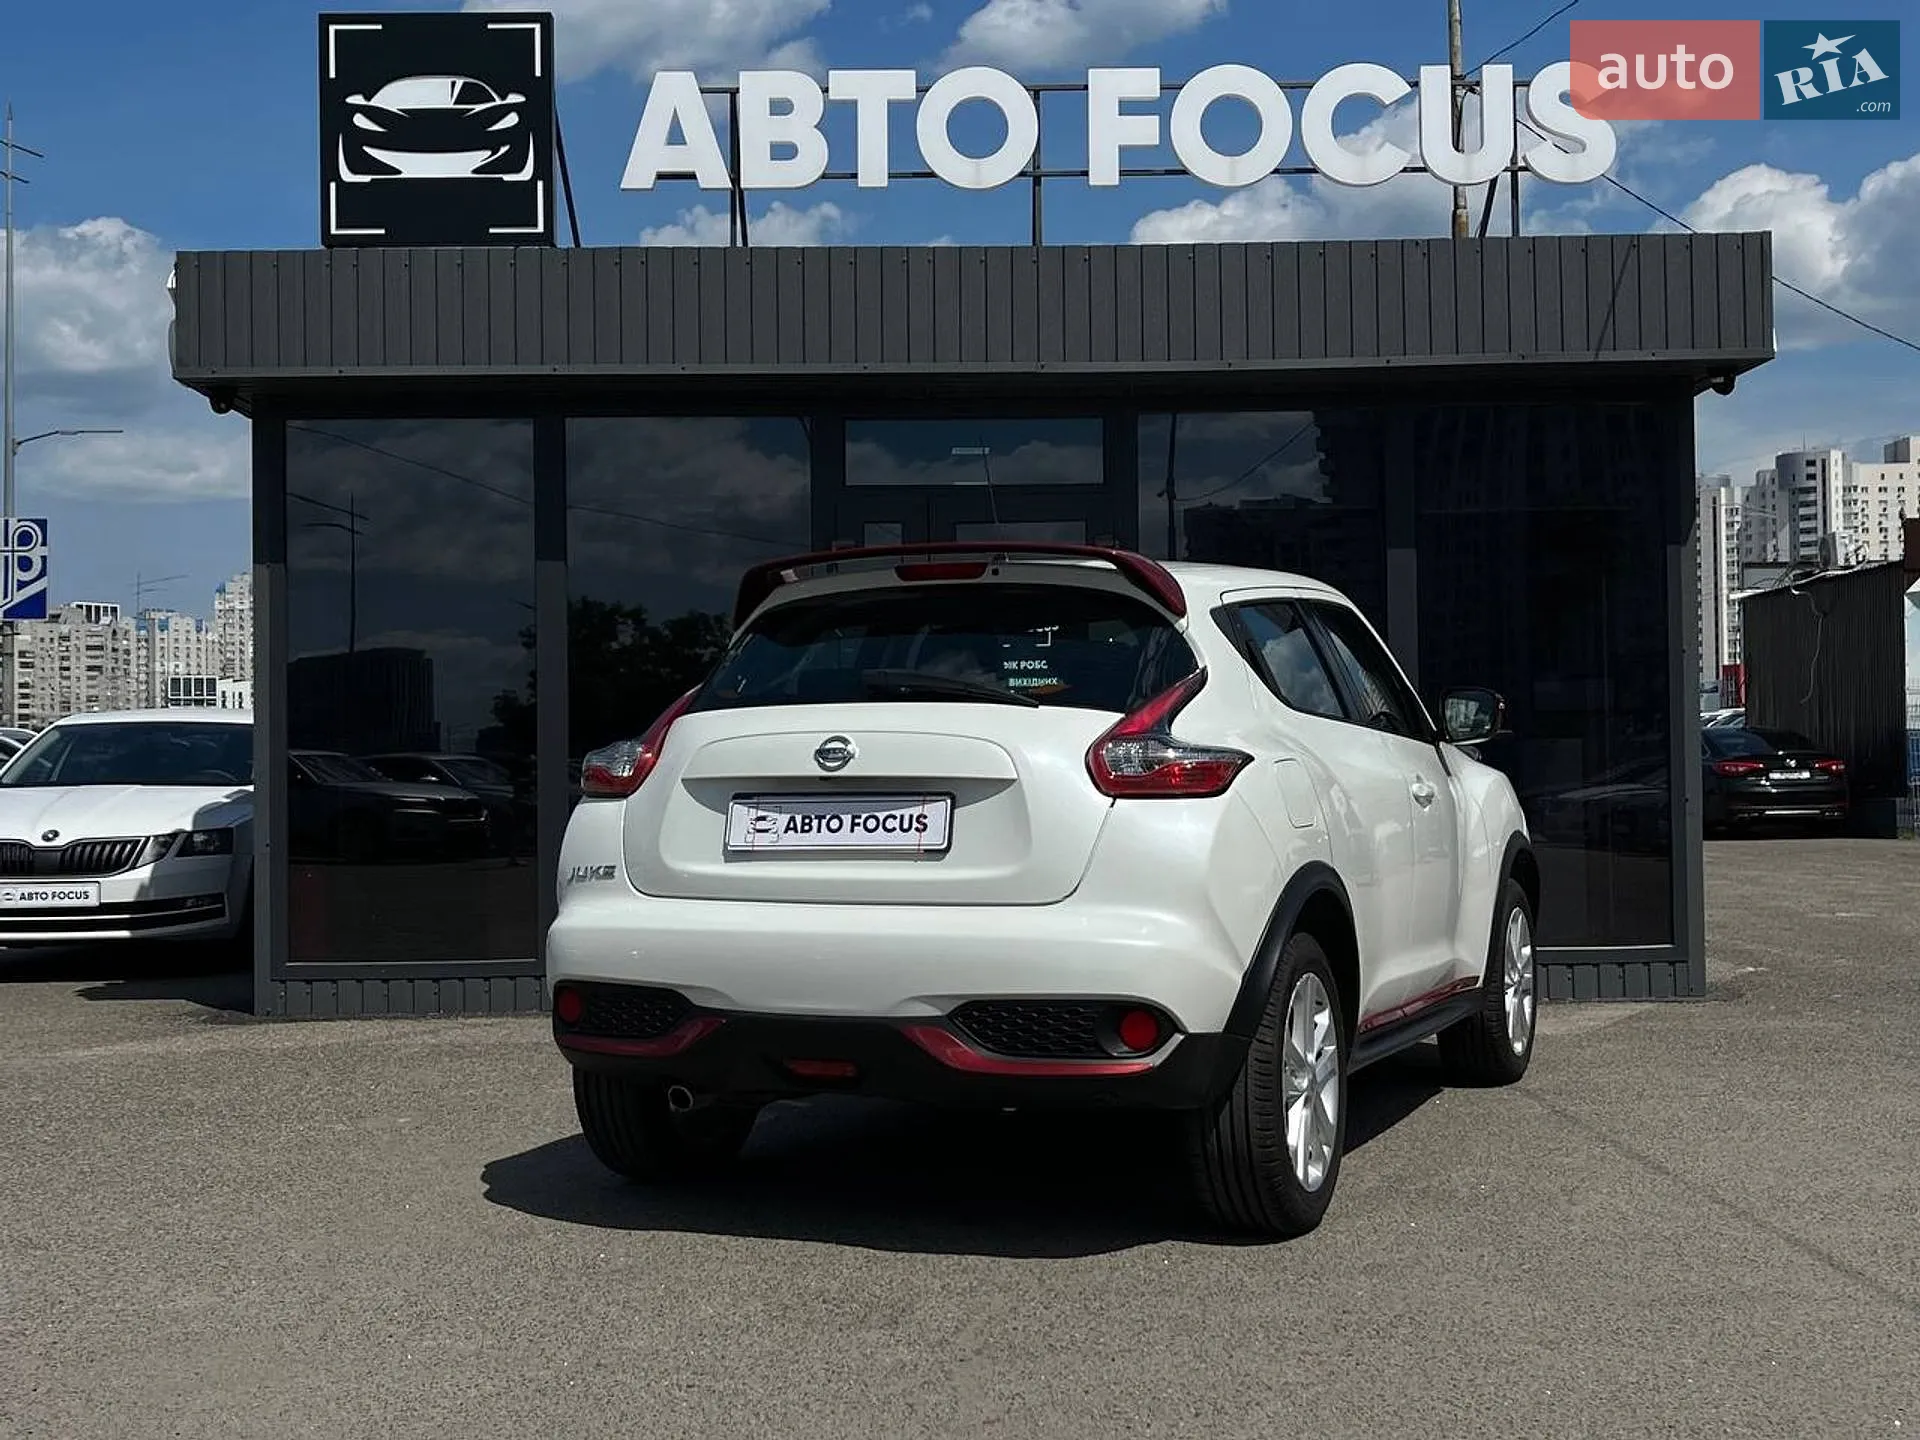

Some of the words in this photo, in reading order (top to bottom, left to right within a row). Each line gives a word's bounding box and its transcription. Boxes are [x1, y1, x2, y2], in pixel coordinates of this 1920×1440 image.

[620, 66, 1040, 191] АВТО
[1088, 62, 1617, 188] FOCUS
[783, 815, 844, 834] АВТО
[850, 813, 929, 833] FOCUS
[566, 864, 617, 885] JUKE
[19, 890, 49, 901] АВТО
[51, 890, 90, 900] FOCUS
